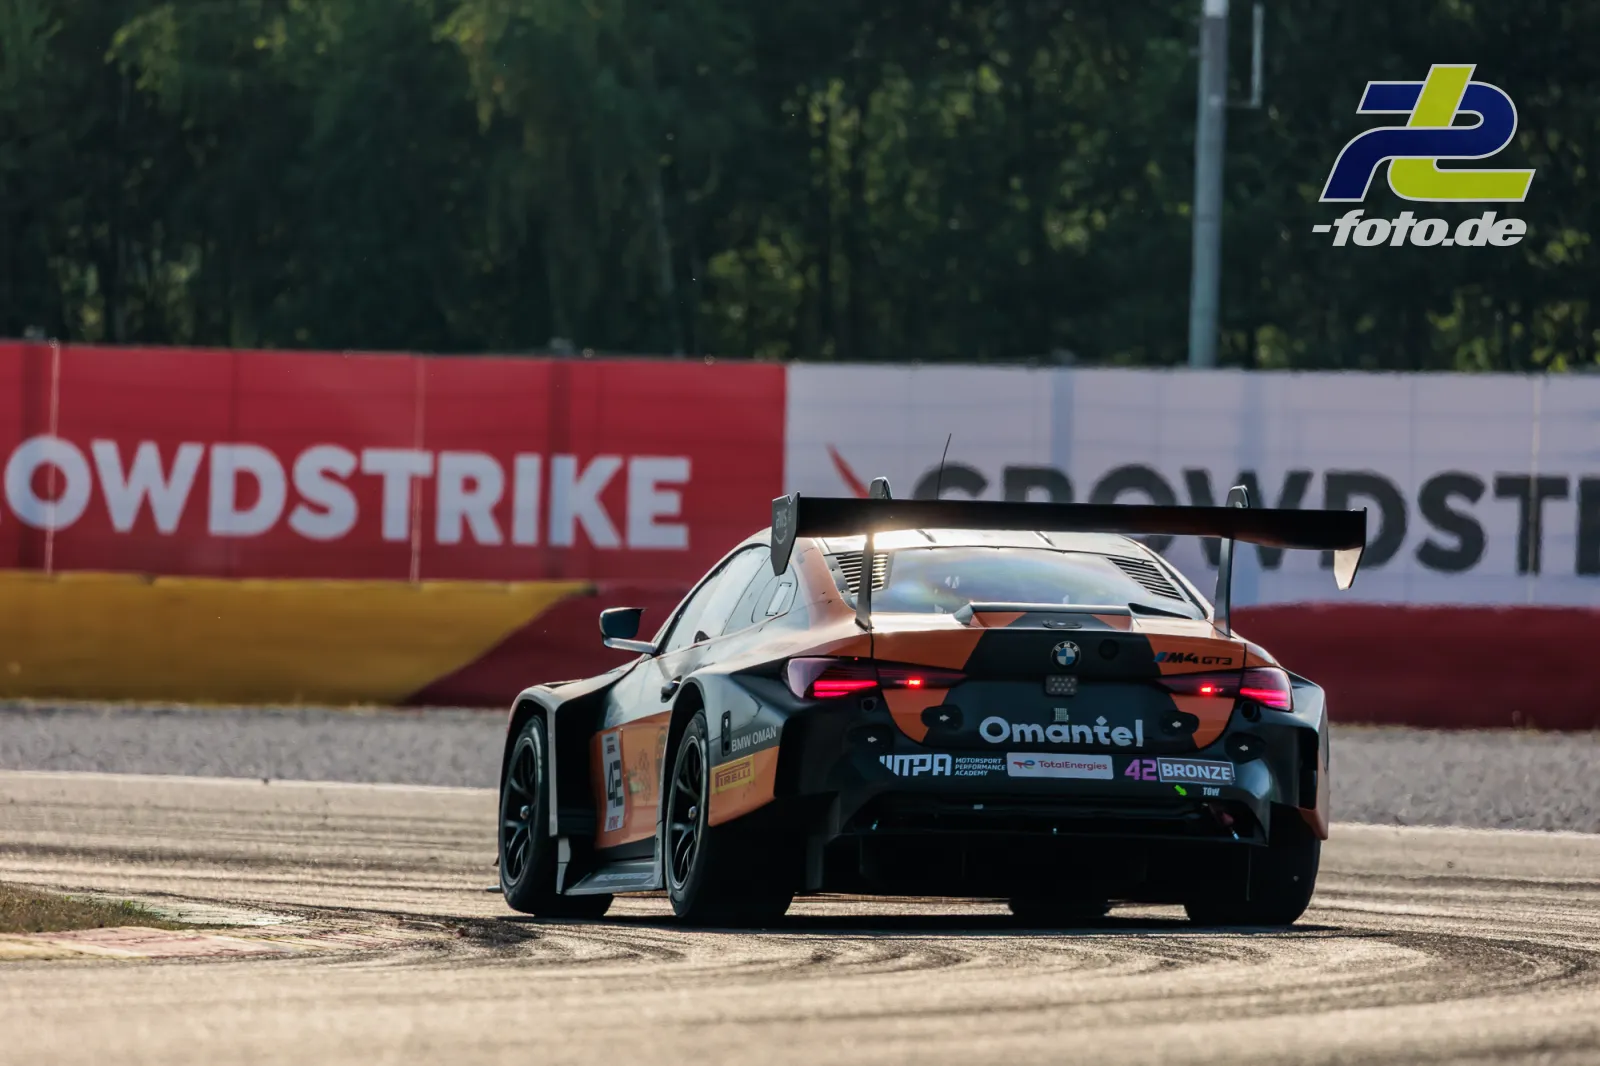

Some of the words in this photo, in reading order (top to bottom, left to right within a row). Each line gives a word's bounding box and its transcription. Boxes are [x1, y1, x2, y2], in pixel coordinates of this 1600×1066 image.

[1201, 656, 1233, 666] GT3
[731, 733, 752, 753] BMW
[752, 725, 777, 746] OMAN
[979, 715, 1144, 748] Omantel
[715, 761, 751, 789] PIRELLI
[1038, 760, 1108, 771] TotalEnergies
[1124, 759, 1158, 781] 42
[1161, 763, 1232, 780] BRONZE
[607, 760, 624, 809] 42
[1203, 787, 1220, 796] TOW
